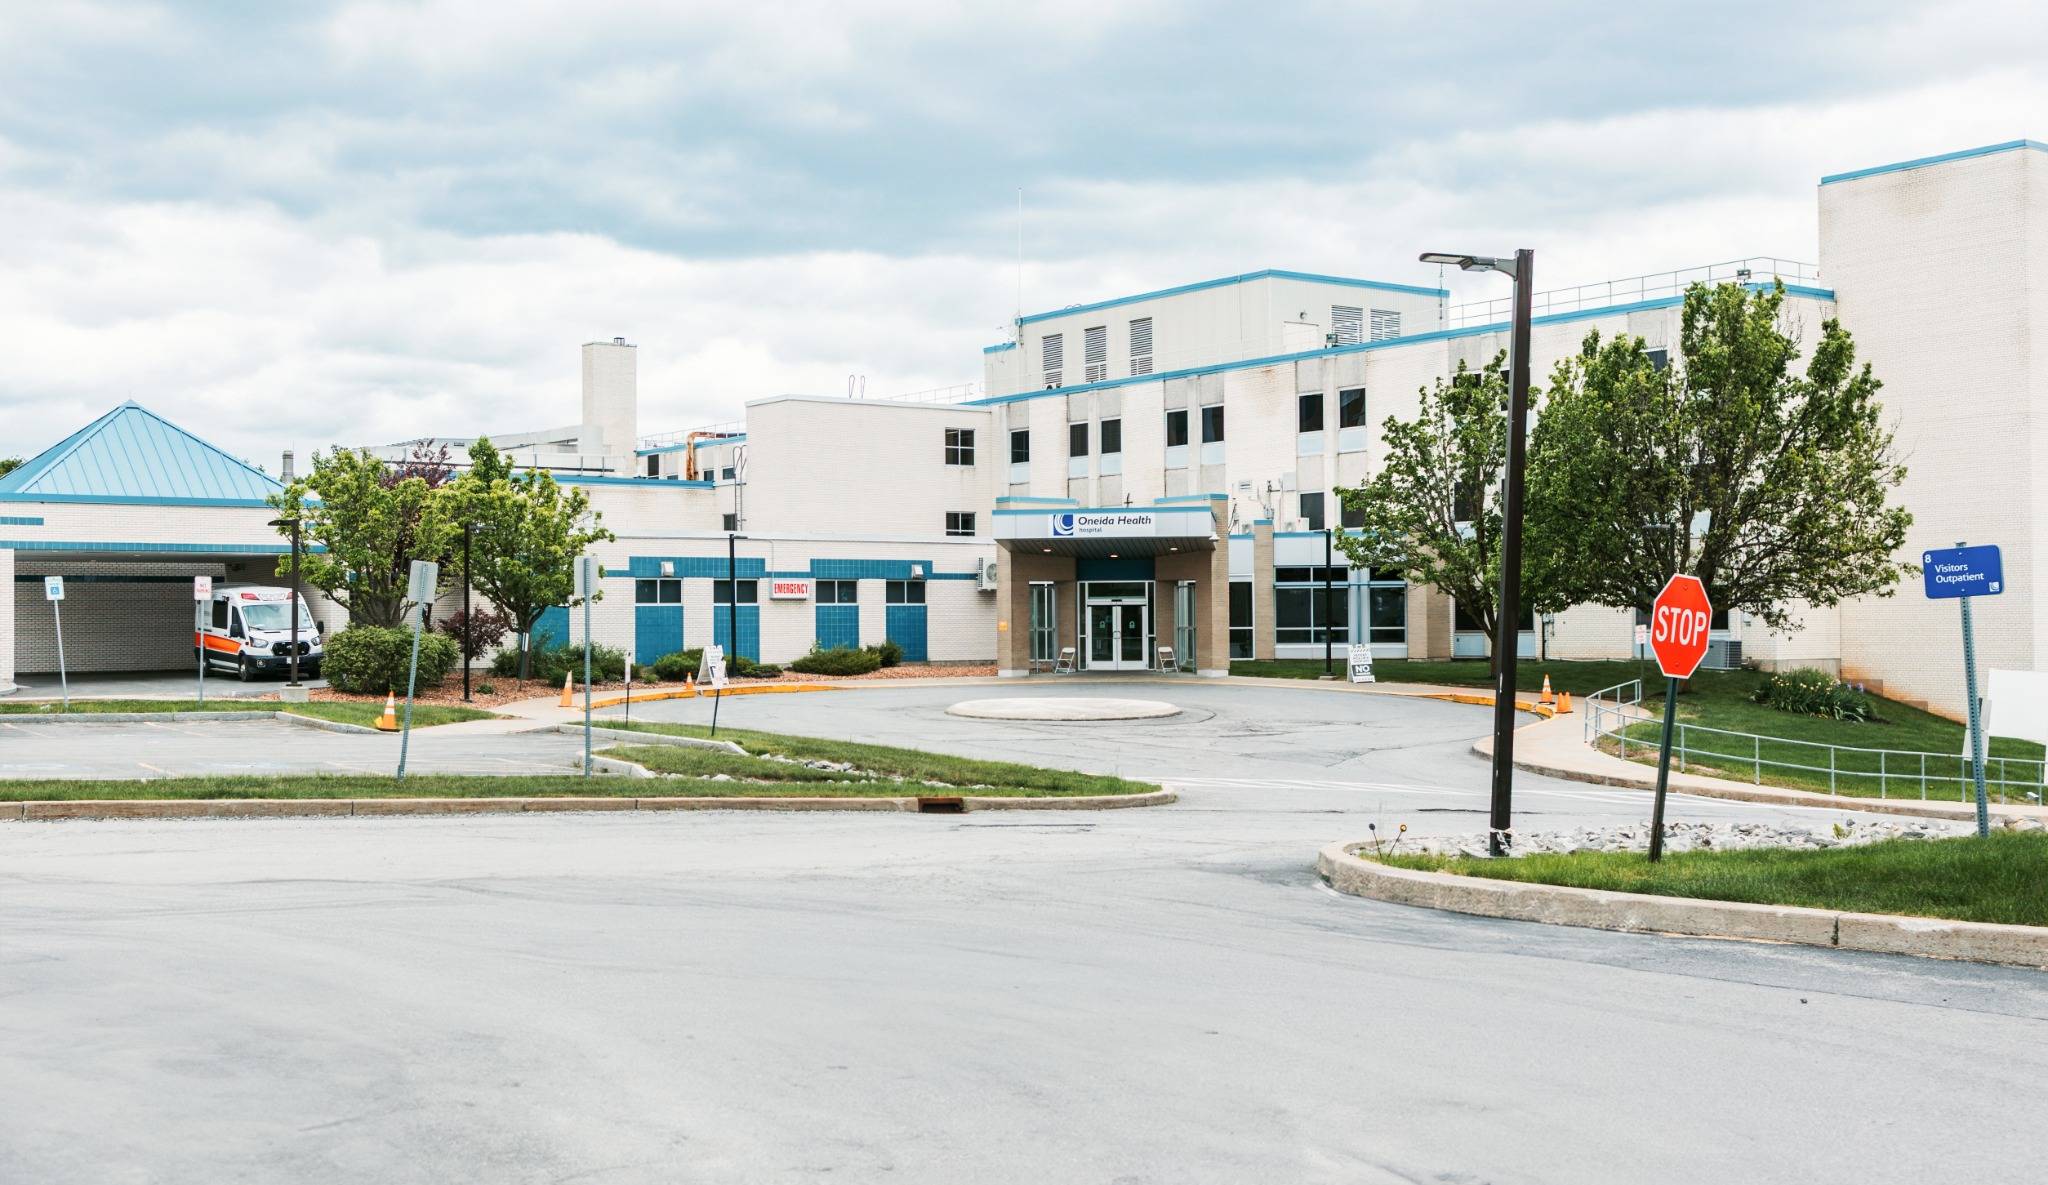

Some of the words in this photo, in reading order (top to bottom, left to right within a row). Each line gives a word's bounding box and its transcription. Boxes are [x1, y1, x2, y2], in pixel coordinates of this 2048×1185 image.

[1078, 516, 1114, 525] Oneida
[1118, 515, 1151, 525] Health
[1924, 554, 1932, 563] 8
[1935, 563, 1968, 573] Visitors
[1935, 573, 1985, 585] Outpatient
[774, 583, 808, 594] EMERGENCY
[1655, 605, 1707, 647] STOP
[1355, 664, 1370, 673] NO
